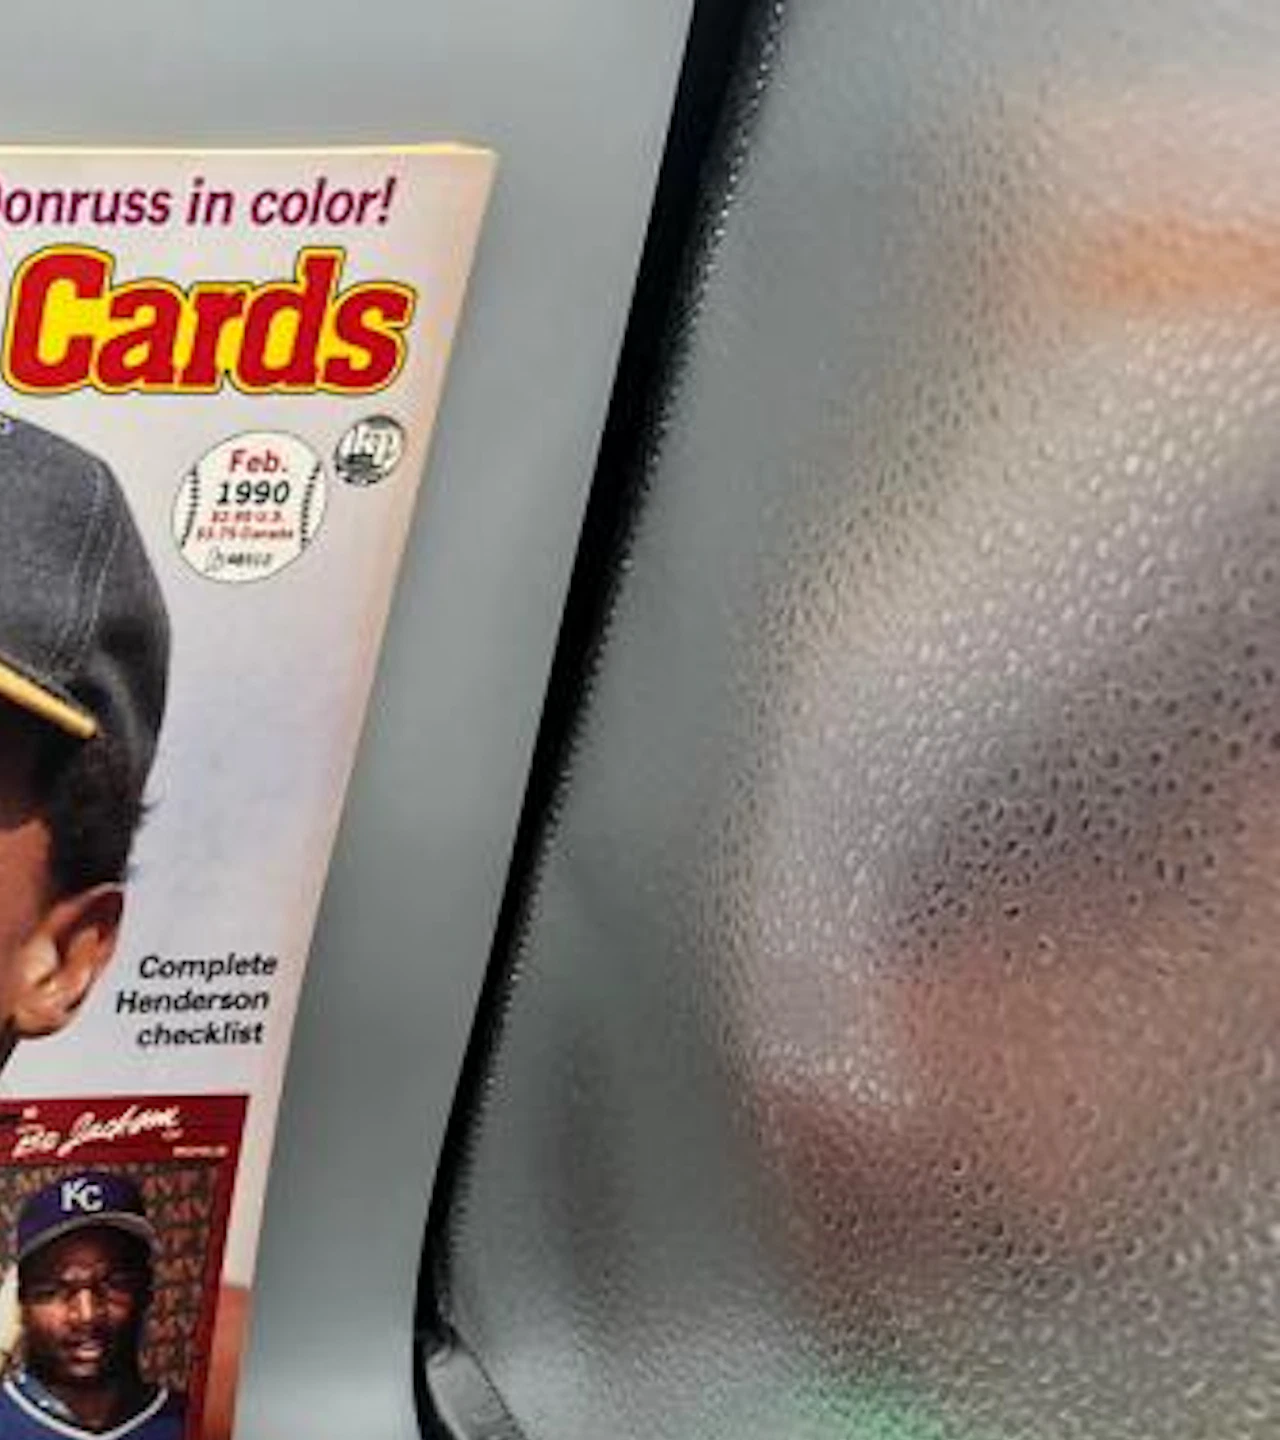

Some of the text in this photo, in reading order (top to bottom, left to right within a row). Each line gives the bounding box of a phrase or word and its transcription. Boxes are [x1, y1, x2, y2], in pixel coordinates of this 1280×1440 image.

[185, 177, 233, 225] in
[249, 176, 398, 226] color!
[0, 244, 420, 396] Cards
[229, 449, 288, 474] Feb.
[215, 480, 290, 506] 1990
[138, 952, 279, 983] Complete
[115, 990, 271, 1015] Henderson
[136, 1022, 266, 1047] checklist
[60, 1176, 104, 1212] KC
